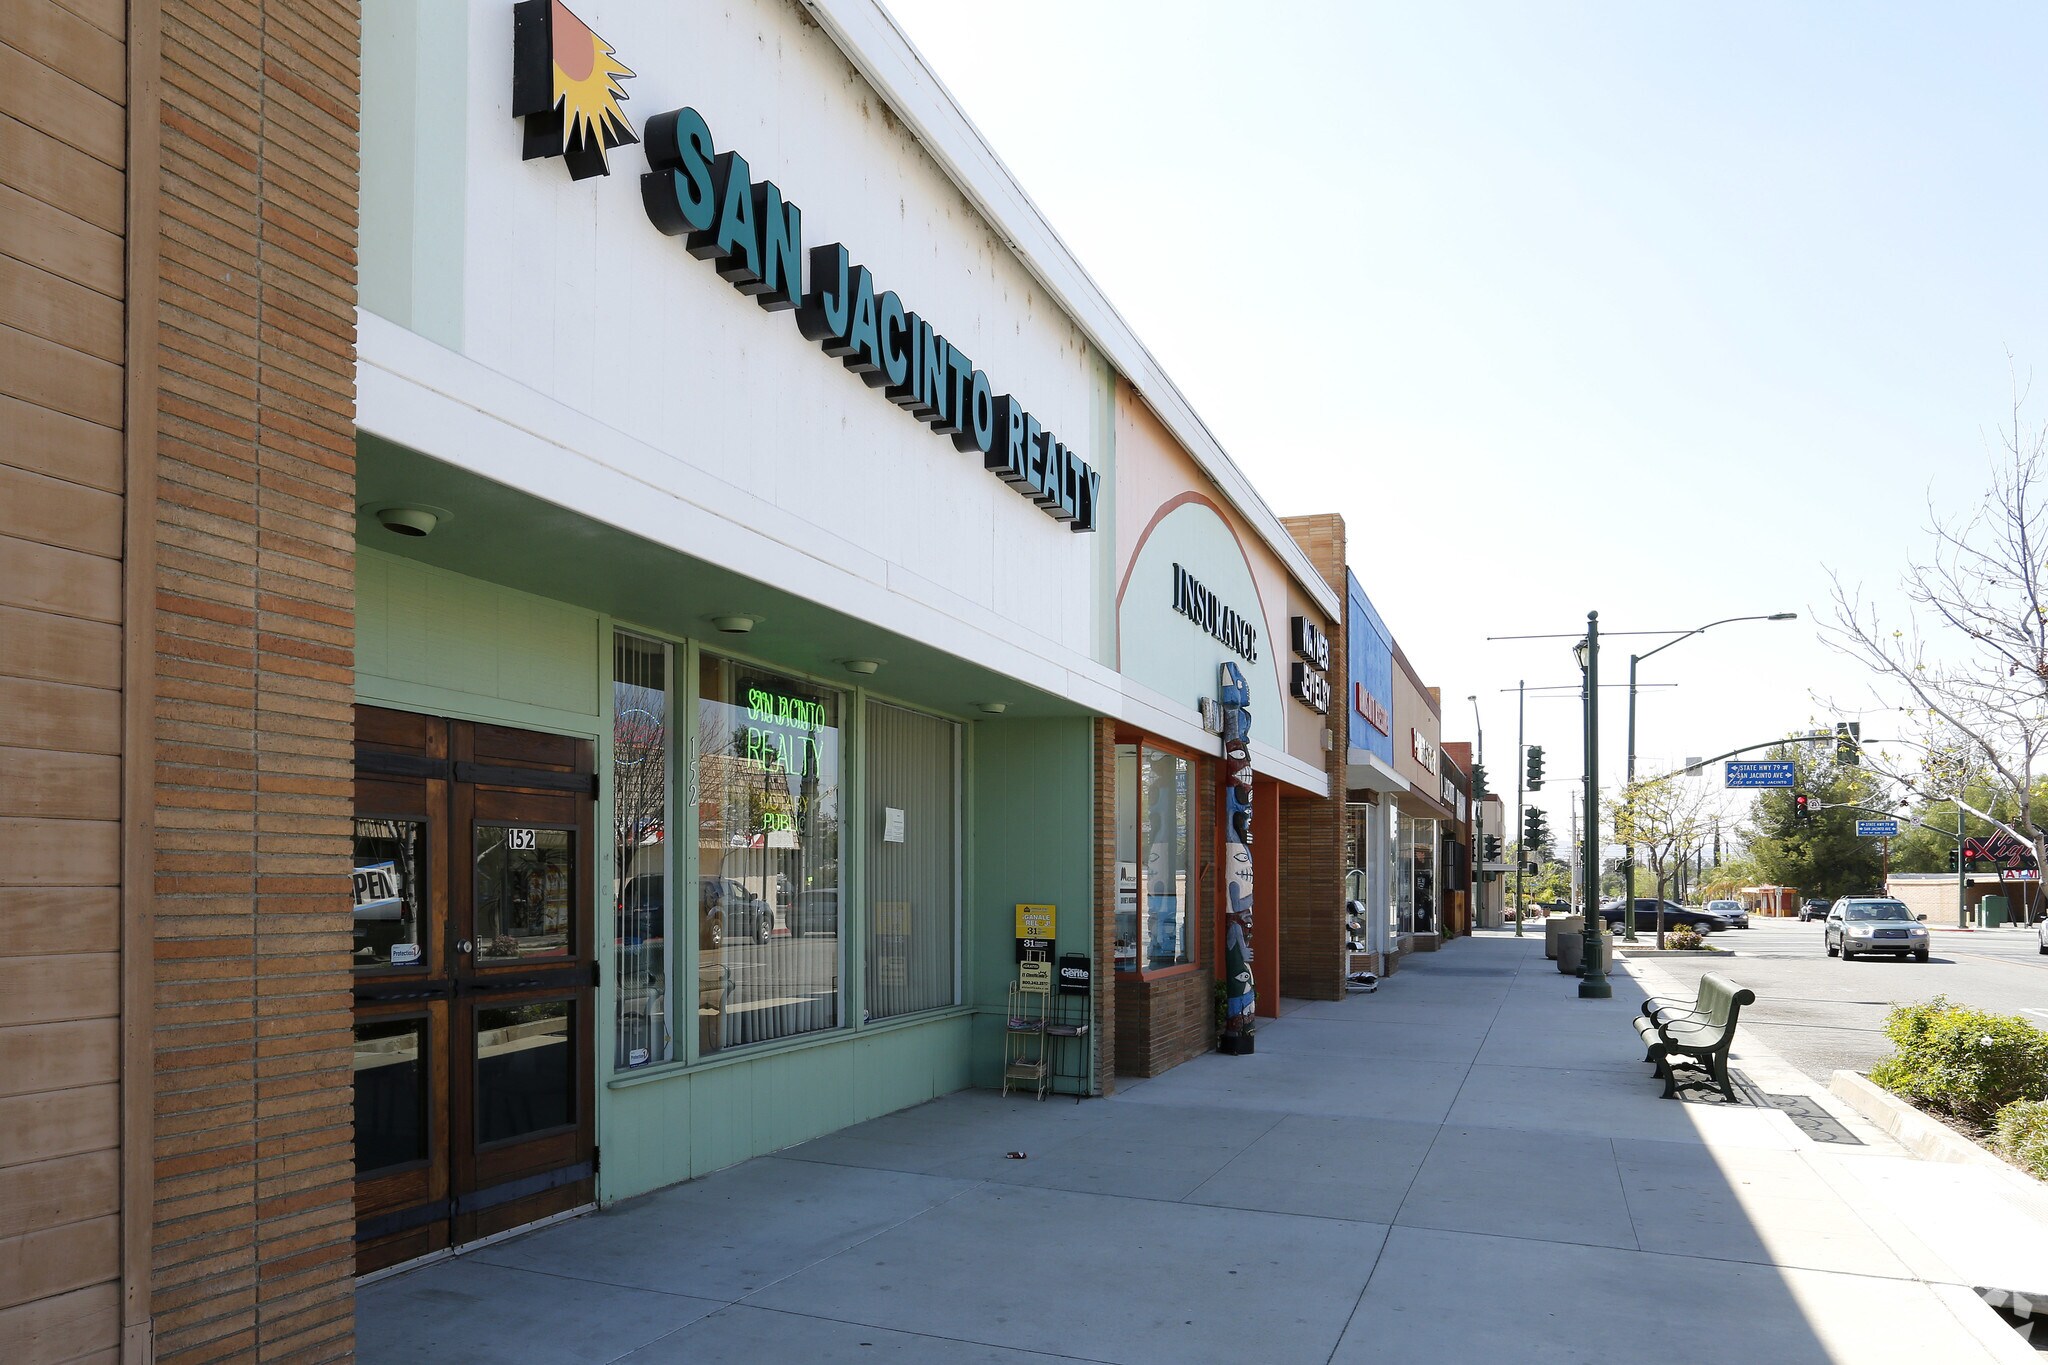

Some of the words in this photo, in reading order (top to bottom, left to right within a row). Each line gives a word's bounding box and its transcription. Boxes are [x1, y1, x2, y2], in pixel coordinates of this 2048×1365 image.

[660, 106, 803, 310] SAN
[806, 241, 994, 453] JACINTO
[995, 394, 1101, 533] REALTY
[1173, 563, 1257, 664] INSURANCE
[1292, 662, 1332, 716] JEWELRY
[747, 688, 774, 723] SAN
[774, 695, 826, 734] JACINTO
[688, 736, 697, 808] 152
[746, 727, 824, 779] REALTY
[760, 792, 808, 813] NOTARY
[509, 829, 534, 849] 152
[762, 812, 807, 834] PUBLIC
[353, 871, 395, 905] PEN
[1023, 939, 1034, 948] 31
[1027, 927, 1037, 935] 31
